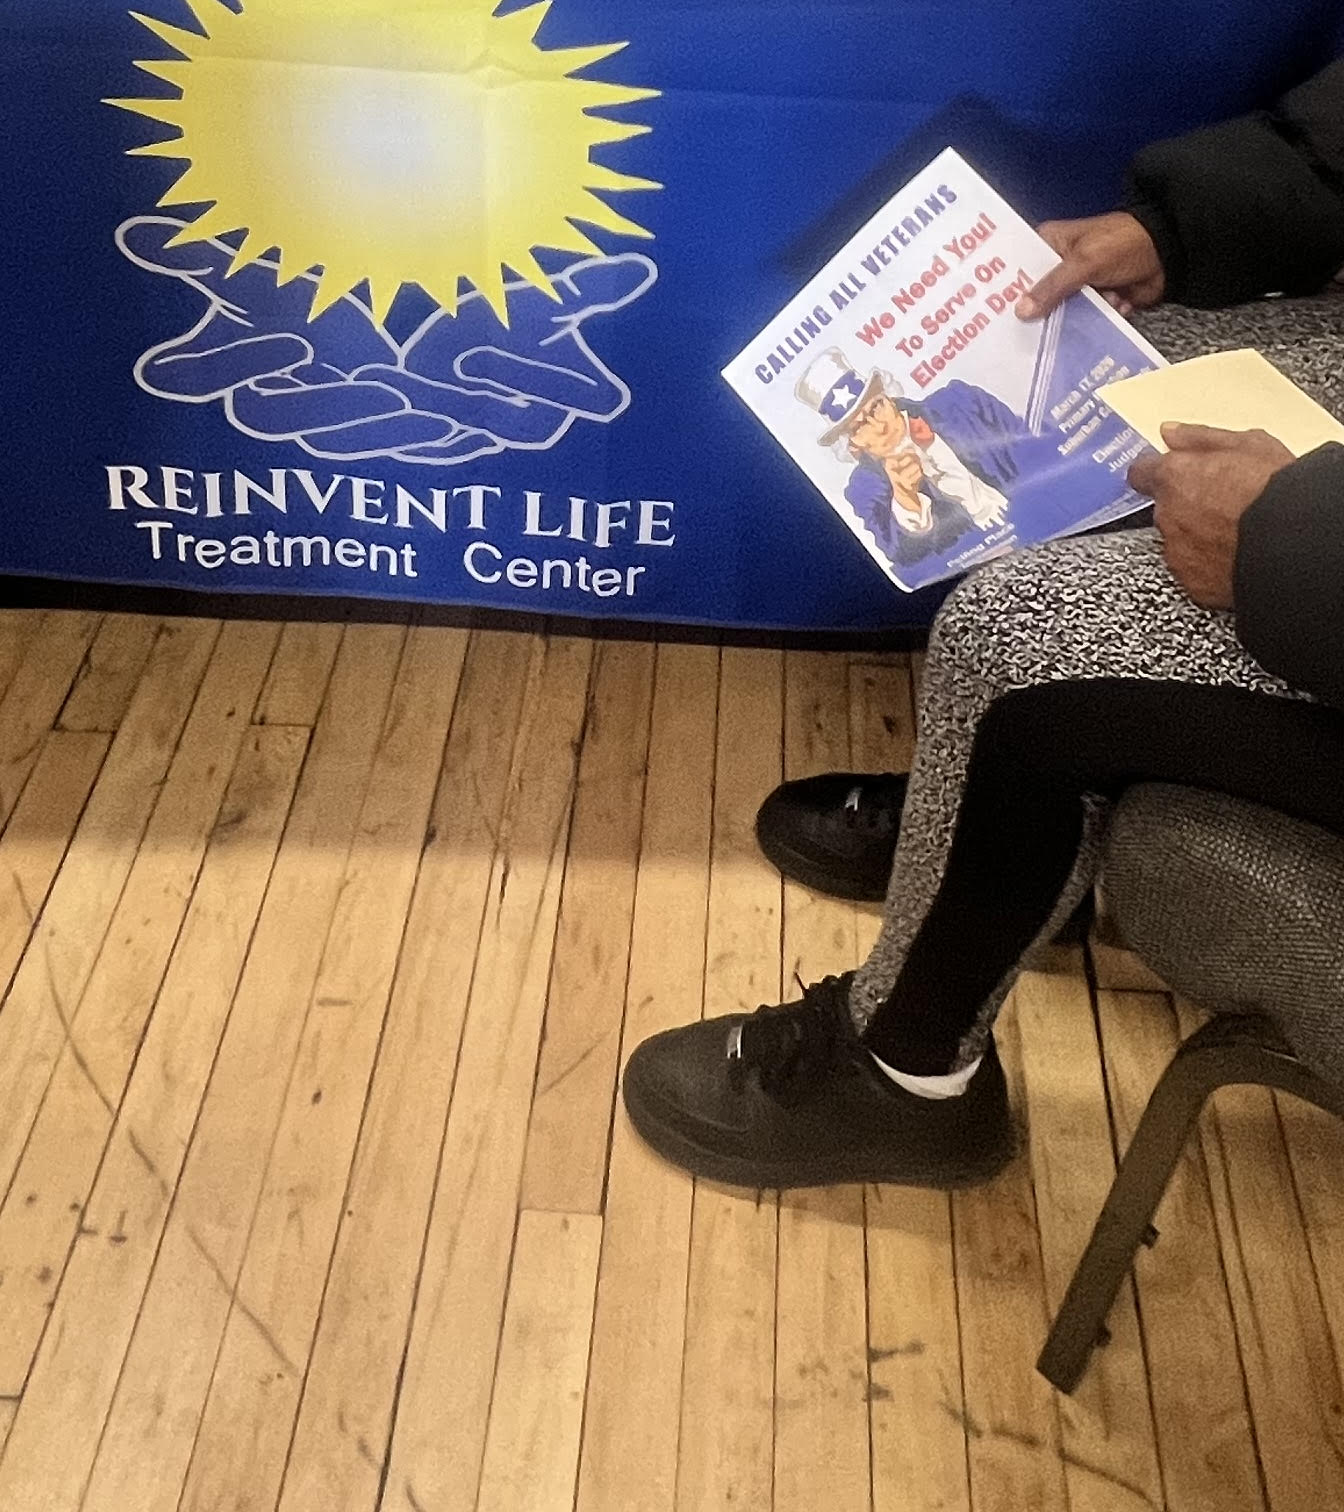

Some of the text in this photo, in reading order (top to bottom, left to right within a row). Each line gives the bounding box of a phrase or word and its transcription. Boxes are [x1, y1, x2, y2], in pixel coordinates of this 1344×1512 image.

[755, 184, 958, 385] CALLING ALL VETERANS
[855, 212, 997, 347] We Need You!
[895, 256, 1006, 358] To Serve On
[910, 268, 1034, 389] Election Day!
[1058, 398, 1096, 434] Primary
[1092, 426, 1136, 464] Electio
[104, 464, 676, 548] REINVENT LIFE
[136, 520, 646, 597] Treatment Center
